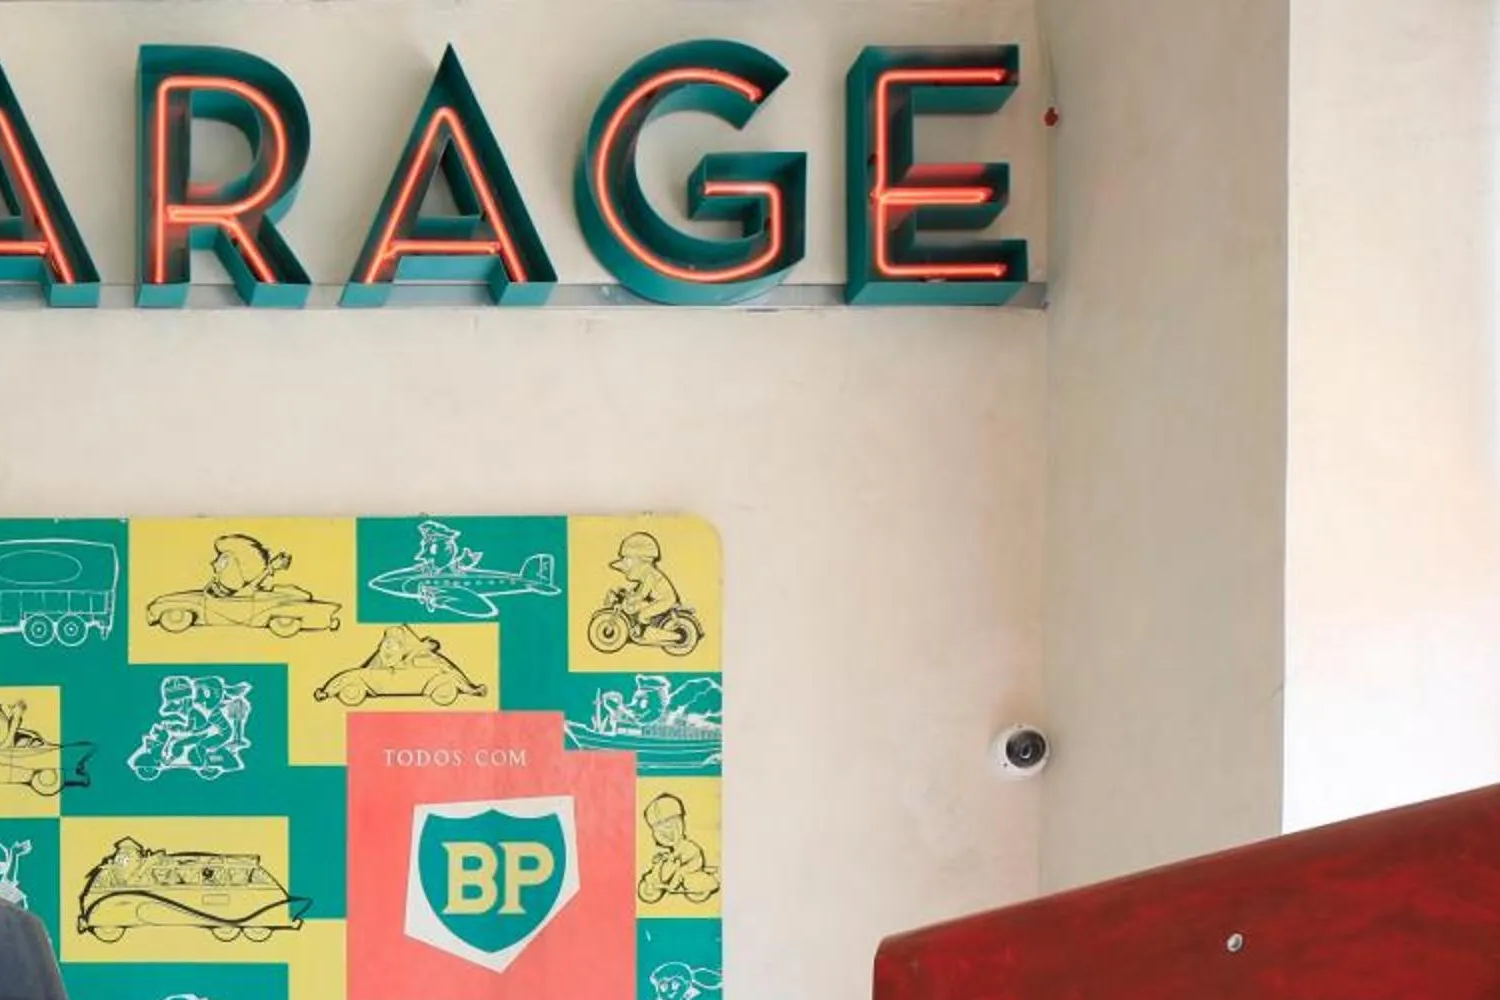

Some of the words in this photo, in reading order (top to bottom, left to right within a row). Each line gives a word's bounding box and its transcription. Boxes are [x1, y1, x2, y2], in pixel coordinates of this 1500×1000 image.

[384, 749, 462, 767] TODOS
[475, 749, 527, 767] COM
[442, 840, 555, 916] BP
